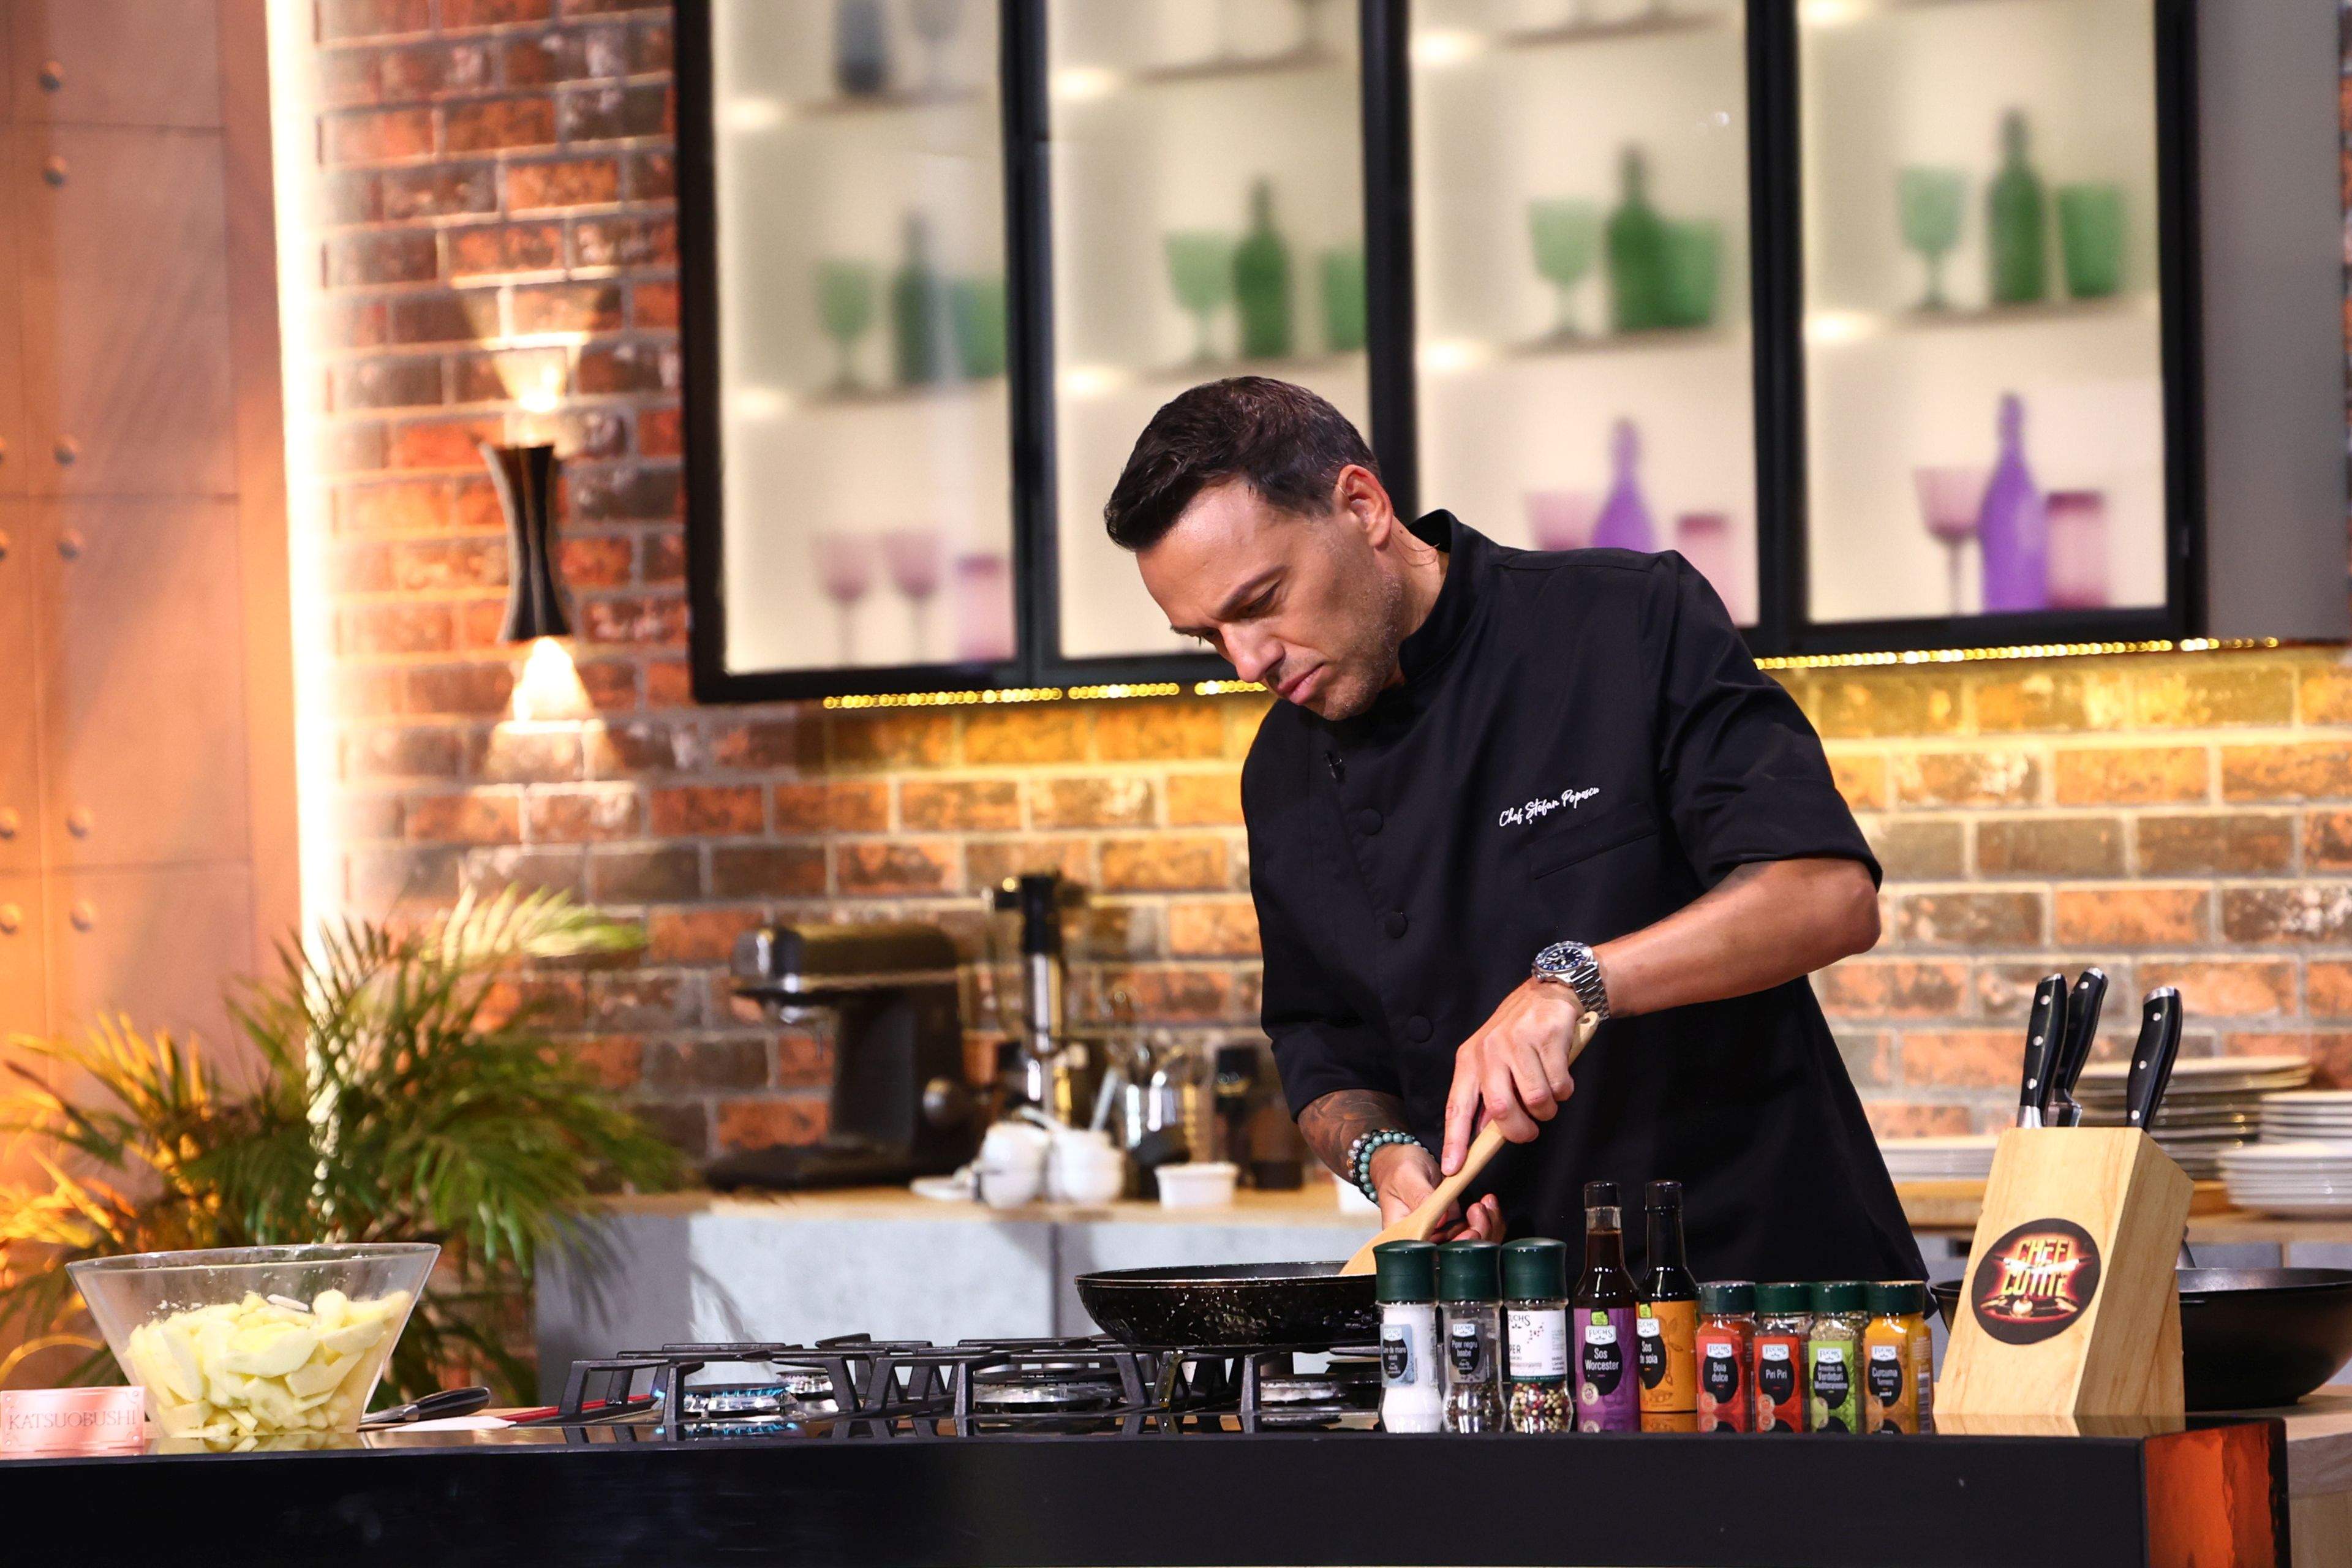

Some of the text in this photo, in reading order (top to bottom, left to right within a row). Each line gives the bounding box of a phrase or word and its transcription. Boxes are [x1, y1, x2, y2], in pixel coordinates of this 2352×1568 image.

[1499, 807, 1523, 827] Chef
[1561, 787, 1600, 809] Popescu
[1588, 1329, 1613, 1339] FUCHS
[1641, 1340, 1653, 1353] Sos
[1594, 1347, 1608, 1360] Sos
[1646, 1354, 1659, 1365] soia
[1585, 1359, 1619, 1371] Worcester
[1713, 1361, 1727, 1373] Boia
[1711, 1372, 1728, 1382] dulce
[1871, 1366, 1898, 1378] Curcuma
[9, 1410, 137, 1430] KATSUOBUSHI
